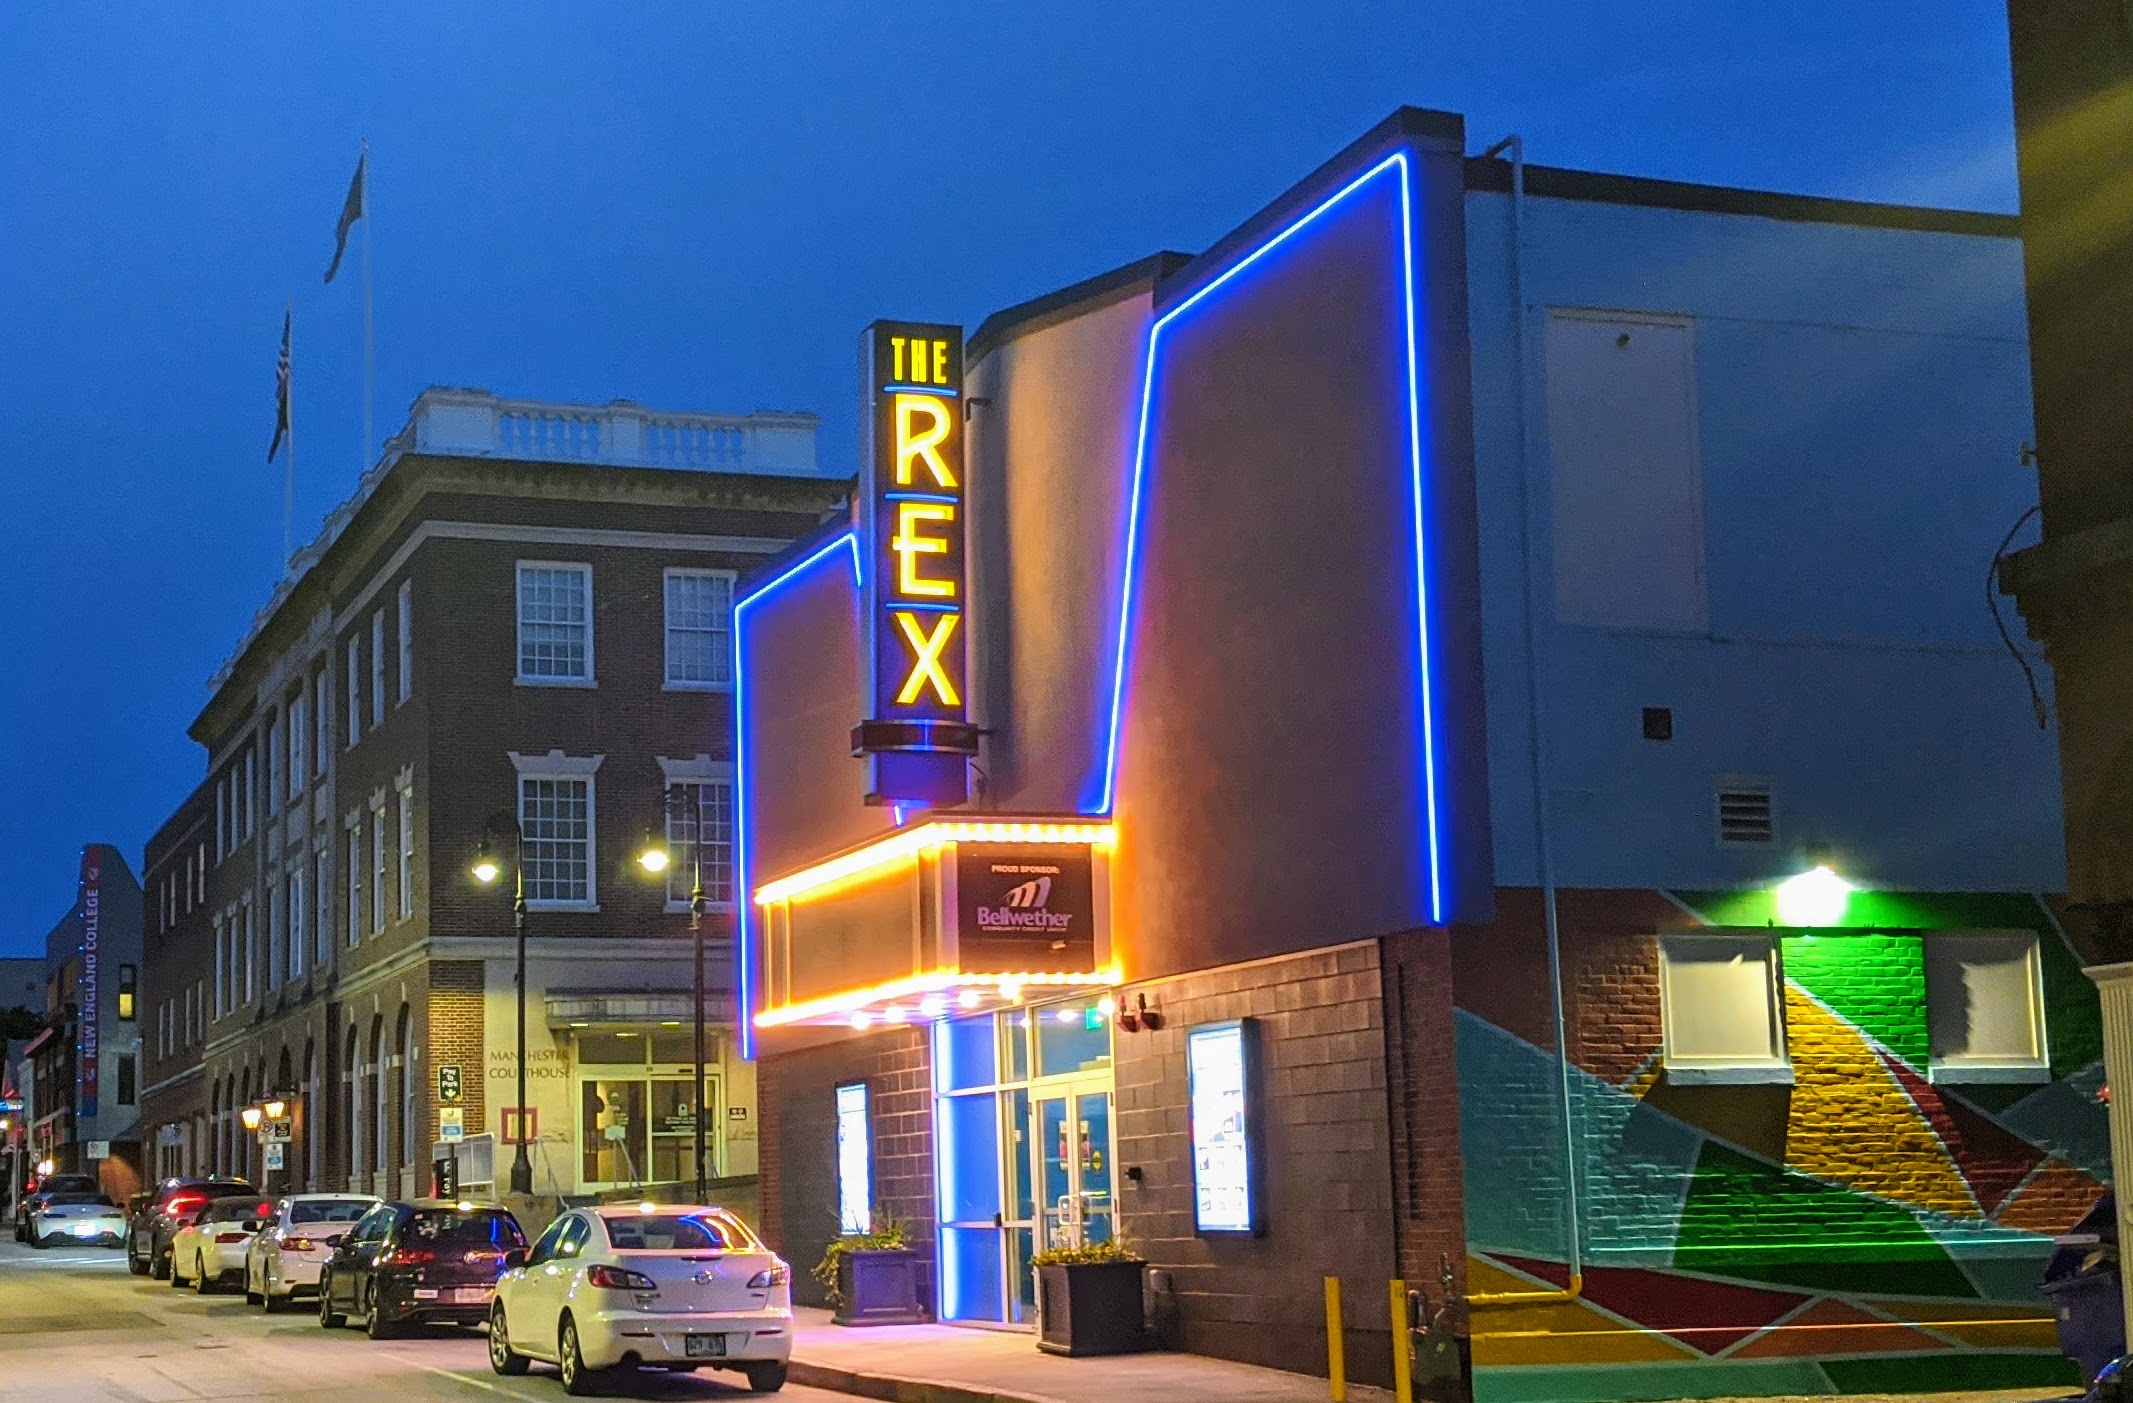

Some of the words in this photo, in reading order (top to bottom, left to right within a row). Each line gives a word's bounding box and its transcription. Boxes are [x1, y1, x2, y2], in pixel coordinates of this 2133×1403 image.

[891, 337, 948, 384] THE
[892, 393, 961, 706] REX
[991, 865, 1019, 873] PROUD
[85, 888, 98, 950] COLLEGE
[977, 906, 1073, 926] Bellwether
[85, 954, 97, 1021] ENGLAND
[84, 1025, 97, 1058] NEW
[490, 1050, 570, 1061] MANHESTER
[489, 1067, 571, 1079] COUTHOUSE
